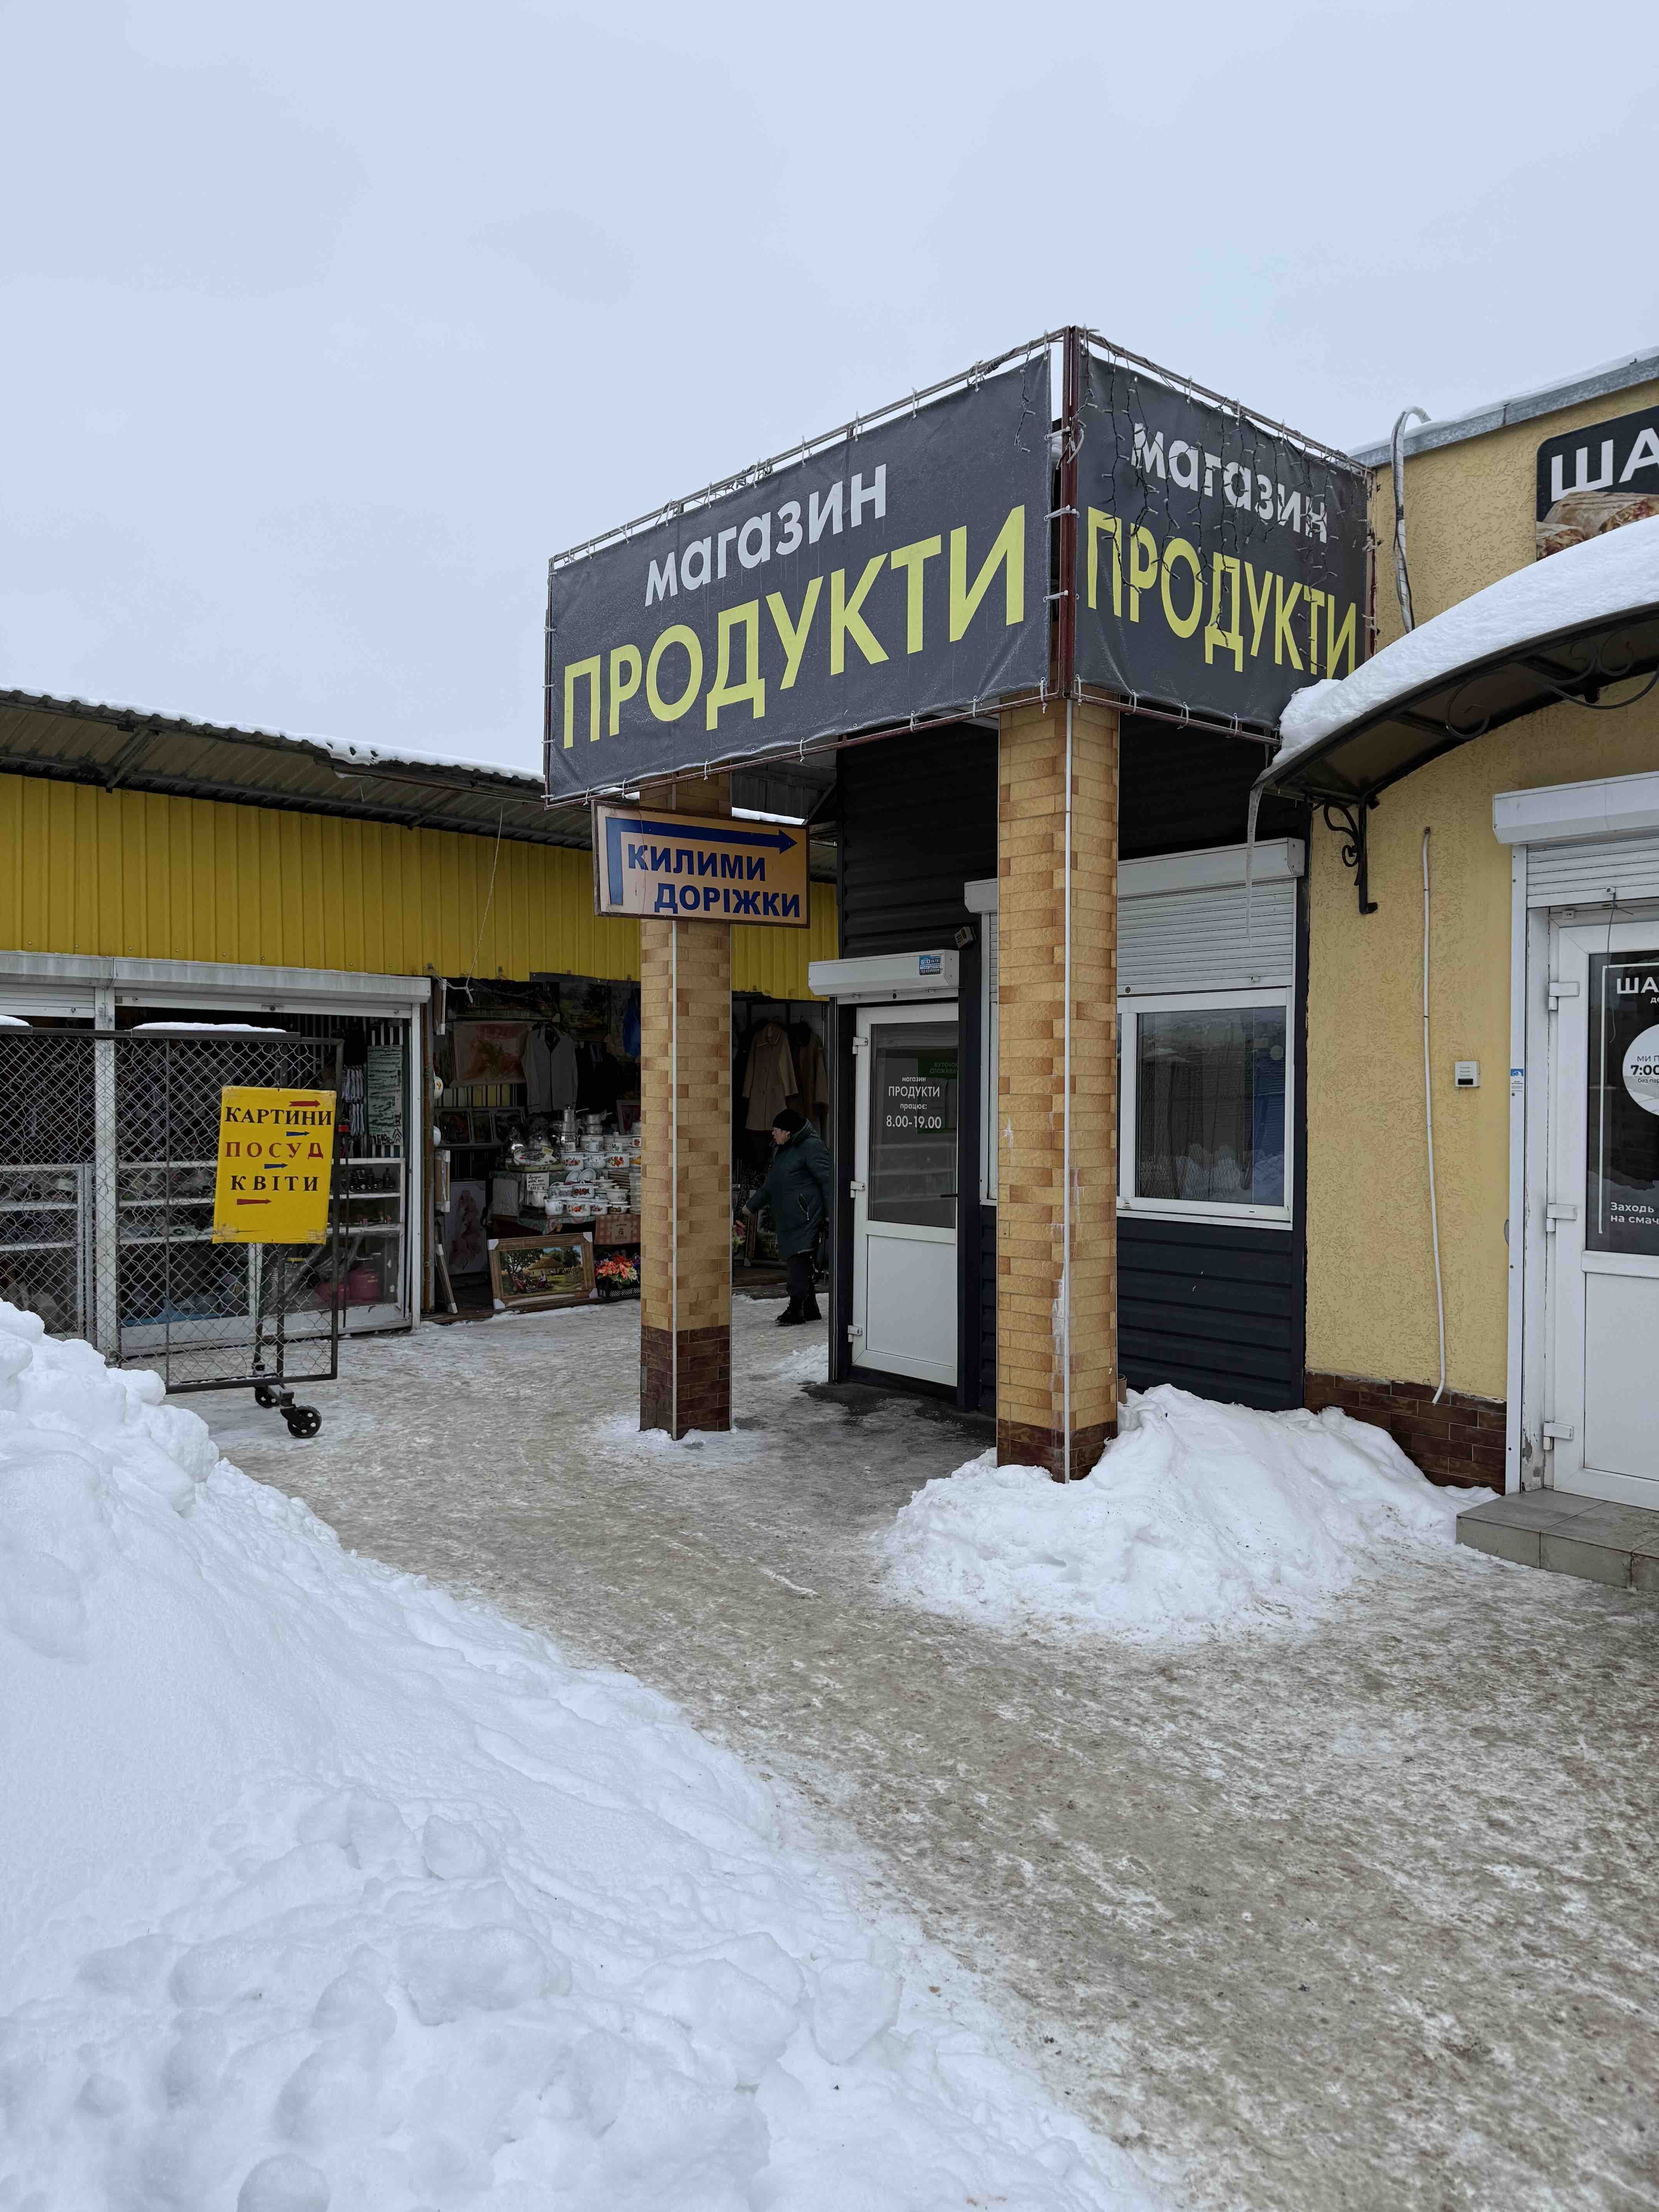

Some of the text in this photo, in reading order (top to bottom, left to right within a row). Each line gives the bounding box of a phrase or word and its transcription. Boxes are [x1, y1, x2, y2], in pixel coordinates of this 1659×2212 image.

[1131, 422, 1327, 543] магазин
[645, 464, 886, 607] магазин
[1087, 507, 1356, 679] ПРОДУКТИ
[564, 505, 1025, 748] ПРОДУКТИ
[628, 843, 766, 881] КИЛИМИ
[654, 883, 800, 917] ДОРІЖКИ
[888, 1086, 940, 1099] ПРОДУКТИ
[225, 1106, 333, 1125] КАРТИНИ
[886, 1115, 941, 1128] 8.00-19.00
[225, 1142, 324, 1159] ПОСУД
[230, 1175, 319, 1191] КВІТИ
[1611, 1202, 1654, 1213] Заходь
